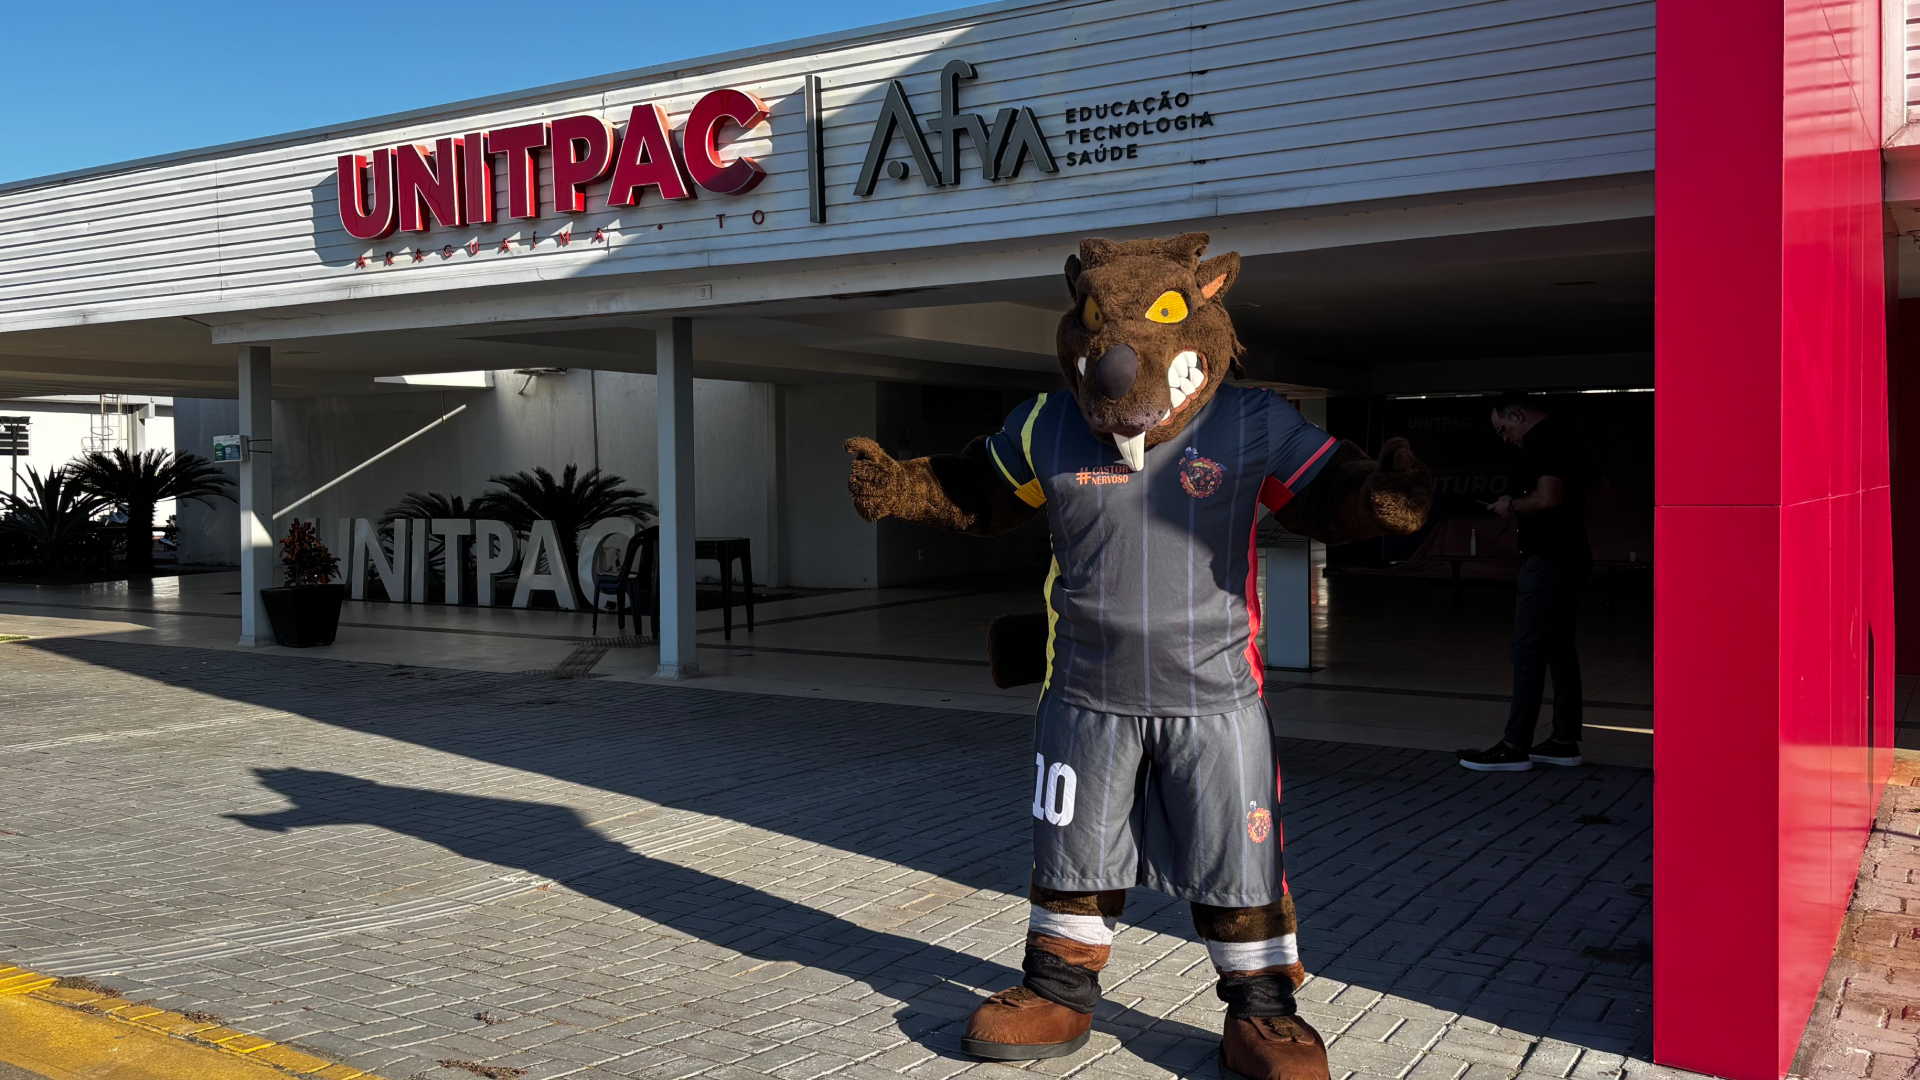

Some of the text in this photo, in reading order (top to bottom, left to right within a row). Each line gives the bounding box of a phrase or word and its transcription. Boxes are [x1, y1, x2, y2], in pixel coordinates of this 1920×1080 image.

[1065, 90, 1191, 124] EDUCAÇÃO
[1065, 110, 1214, 146] TECNOLOGIA
[337, 88, 770, 239] UNITPAC
[1066, 143, 1139, 167] SAÚDE
[355, 208, 766, 269] ARAGUAÍNA TO
[1409, 417, 1471, 429] UNITPAC
[1092, 474, 1129, 485] NERVOSO
[1032, 752, 1077, 827] 10
